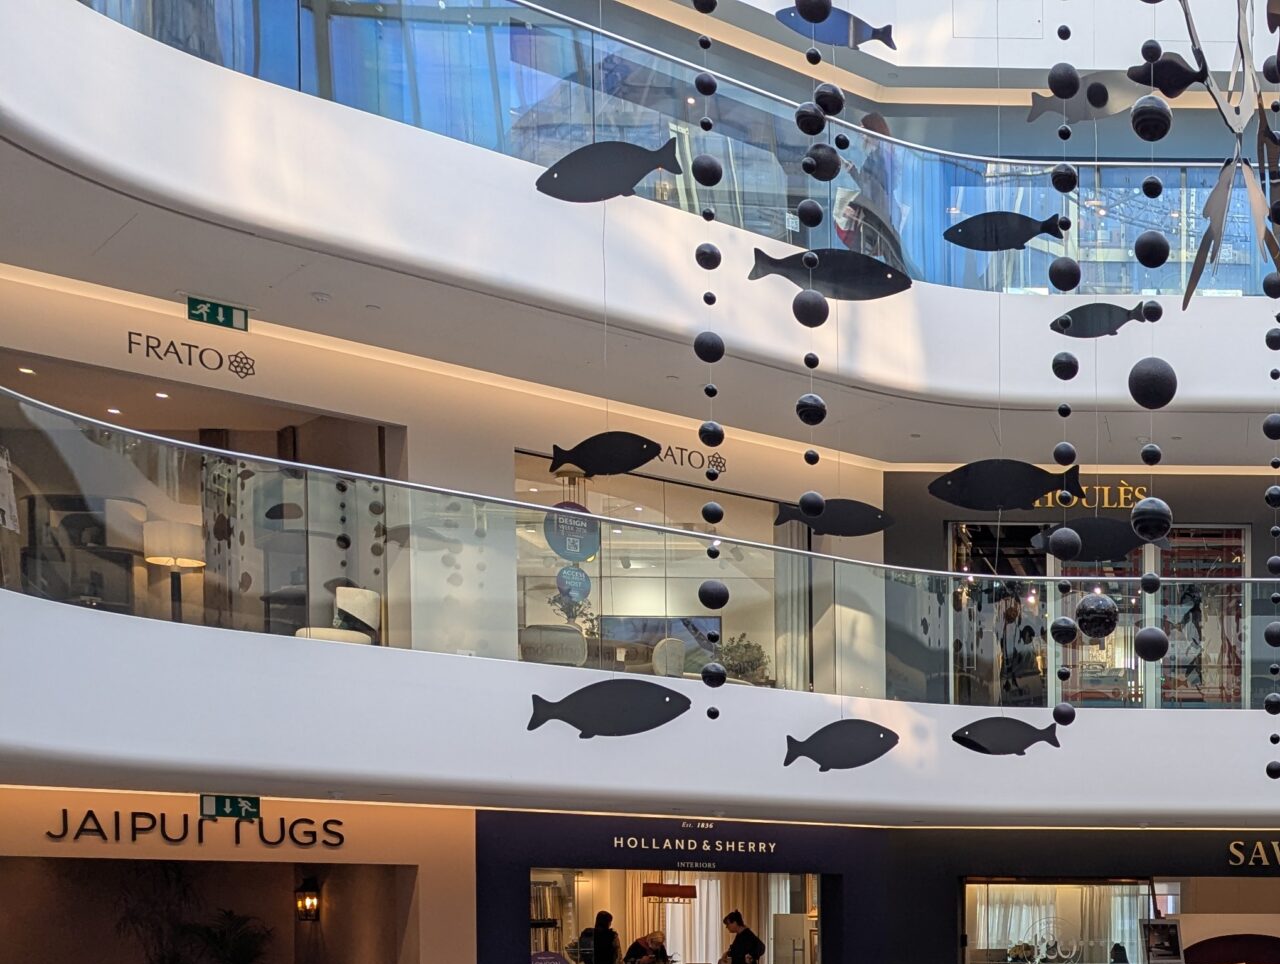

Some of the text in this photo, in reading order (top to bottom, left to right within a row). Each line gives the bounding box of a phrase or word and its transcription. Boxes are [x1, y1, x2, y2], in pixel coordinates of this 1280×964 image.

[128, 331, 224, 371] FRATO
[653, 446, 705, 469] ATO
[559, 517, 587, 528] DESIGN
[614, 837, 777, 853] HOLLAND & SHERRY
[677, 861, 716, 869] INTERIORS
